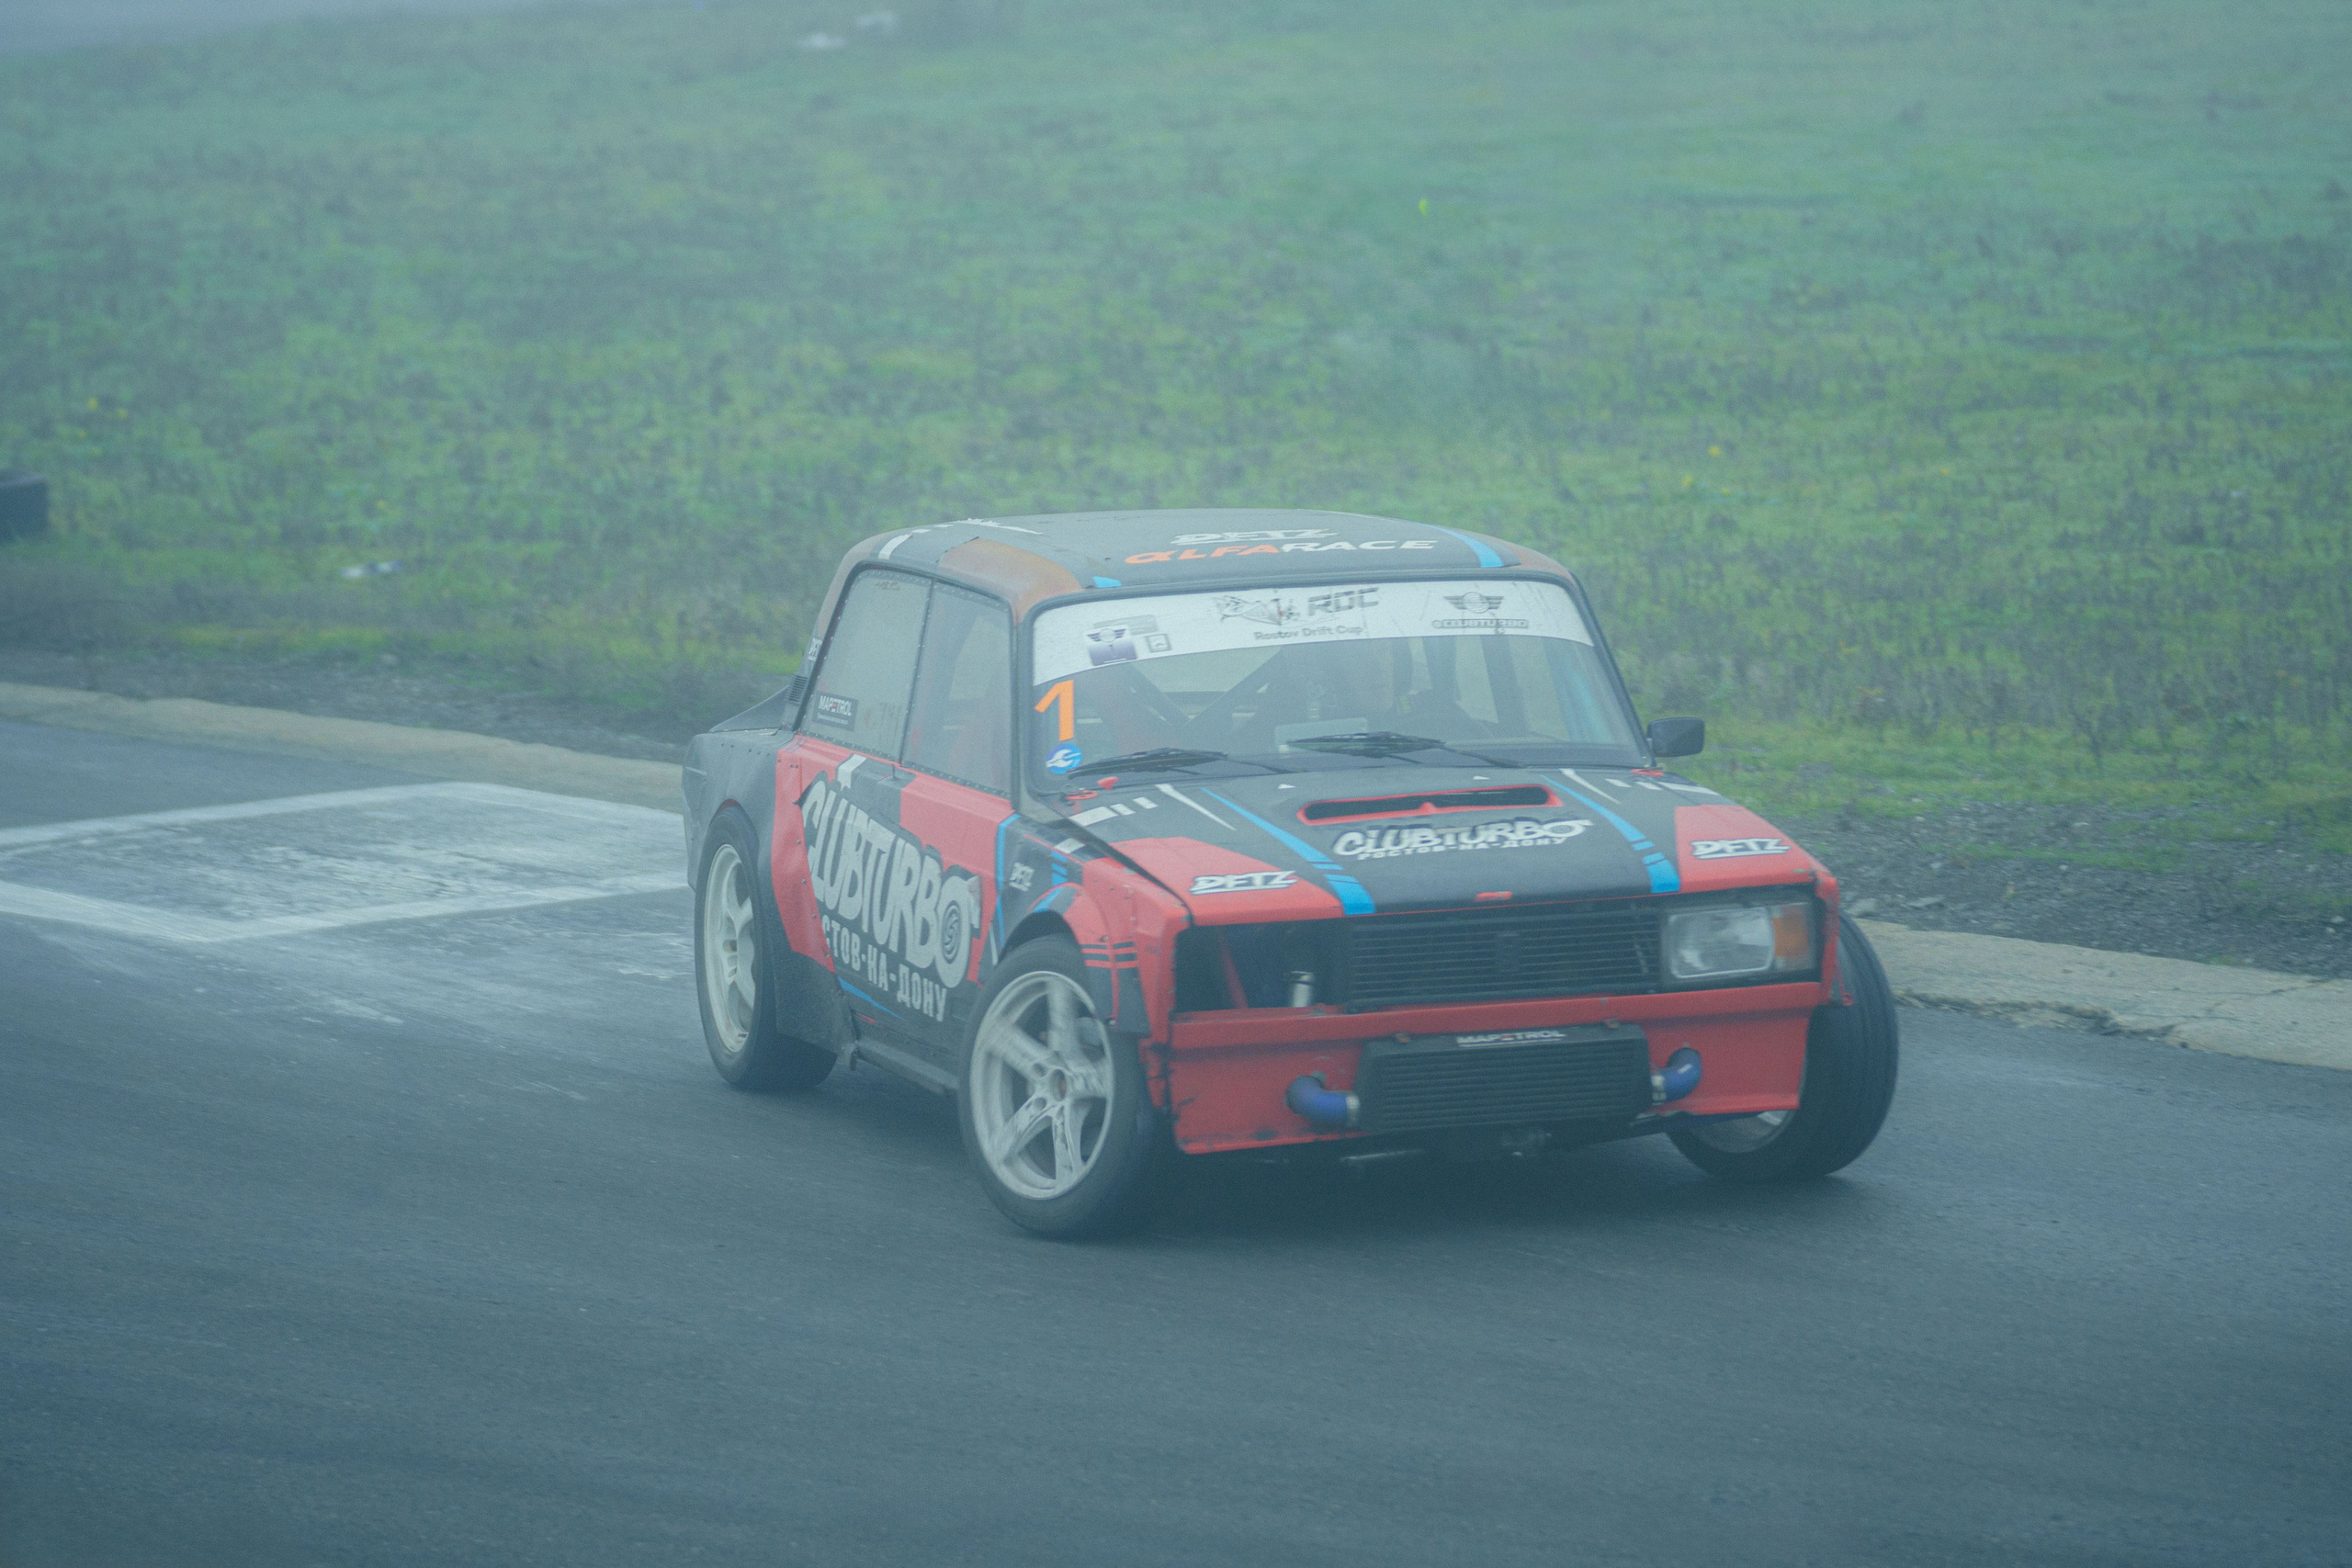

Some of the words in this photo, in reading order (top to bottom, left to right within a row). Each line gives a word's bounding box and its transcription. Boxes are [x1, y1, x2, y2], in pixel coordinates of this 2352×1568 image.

[1253, 629, 1299, 641] Rostov
[1302, 626, 1334, 637] Drift
[1336, 625, 1363, 637] Cup
[1034, 679, 1075, 742] 1
[1332, 818, 1594, 856] CLUBTURBO
[1455, 1030, 1567, 1044] MAPETROL
